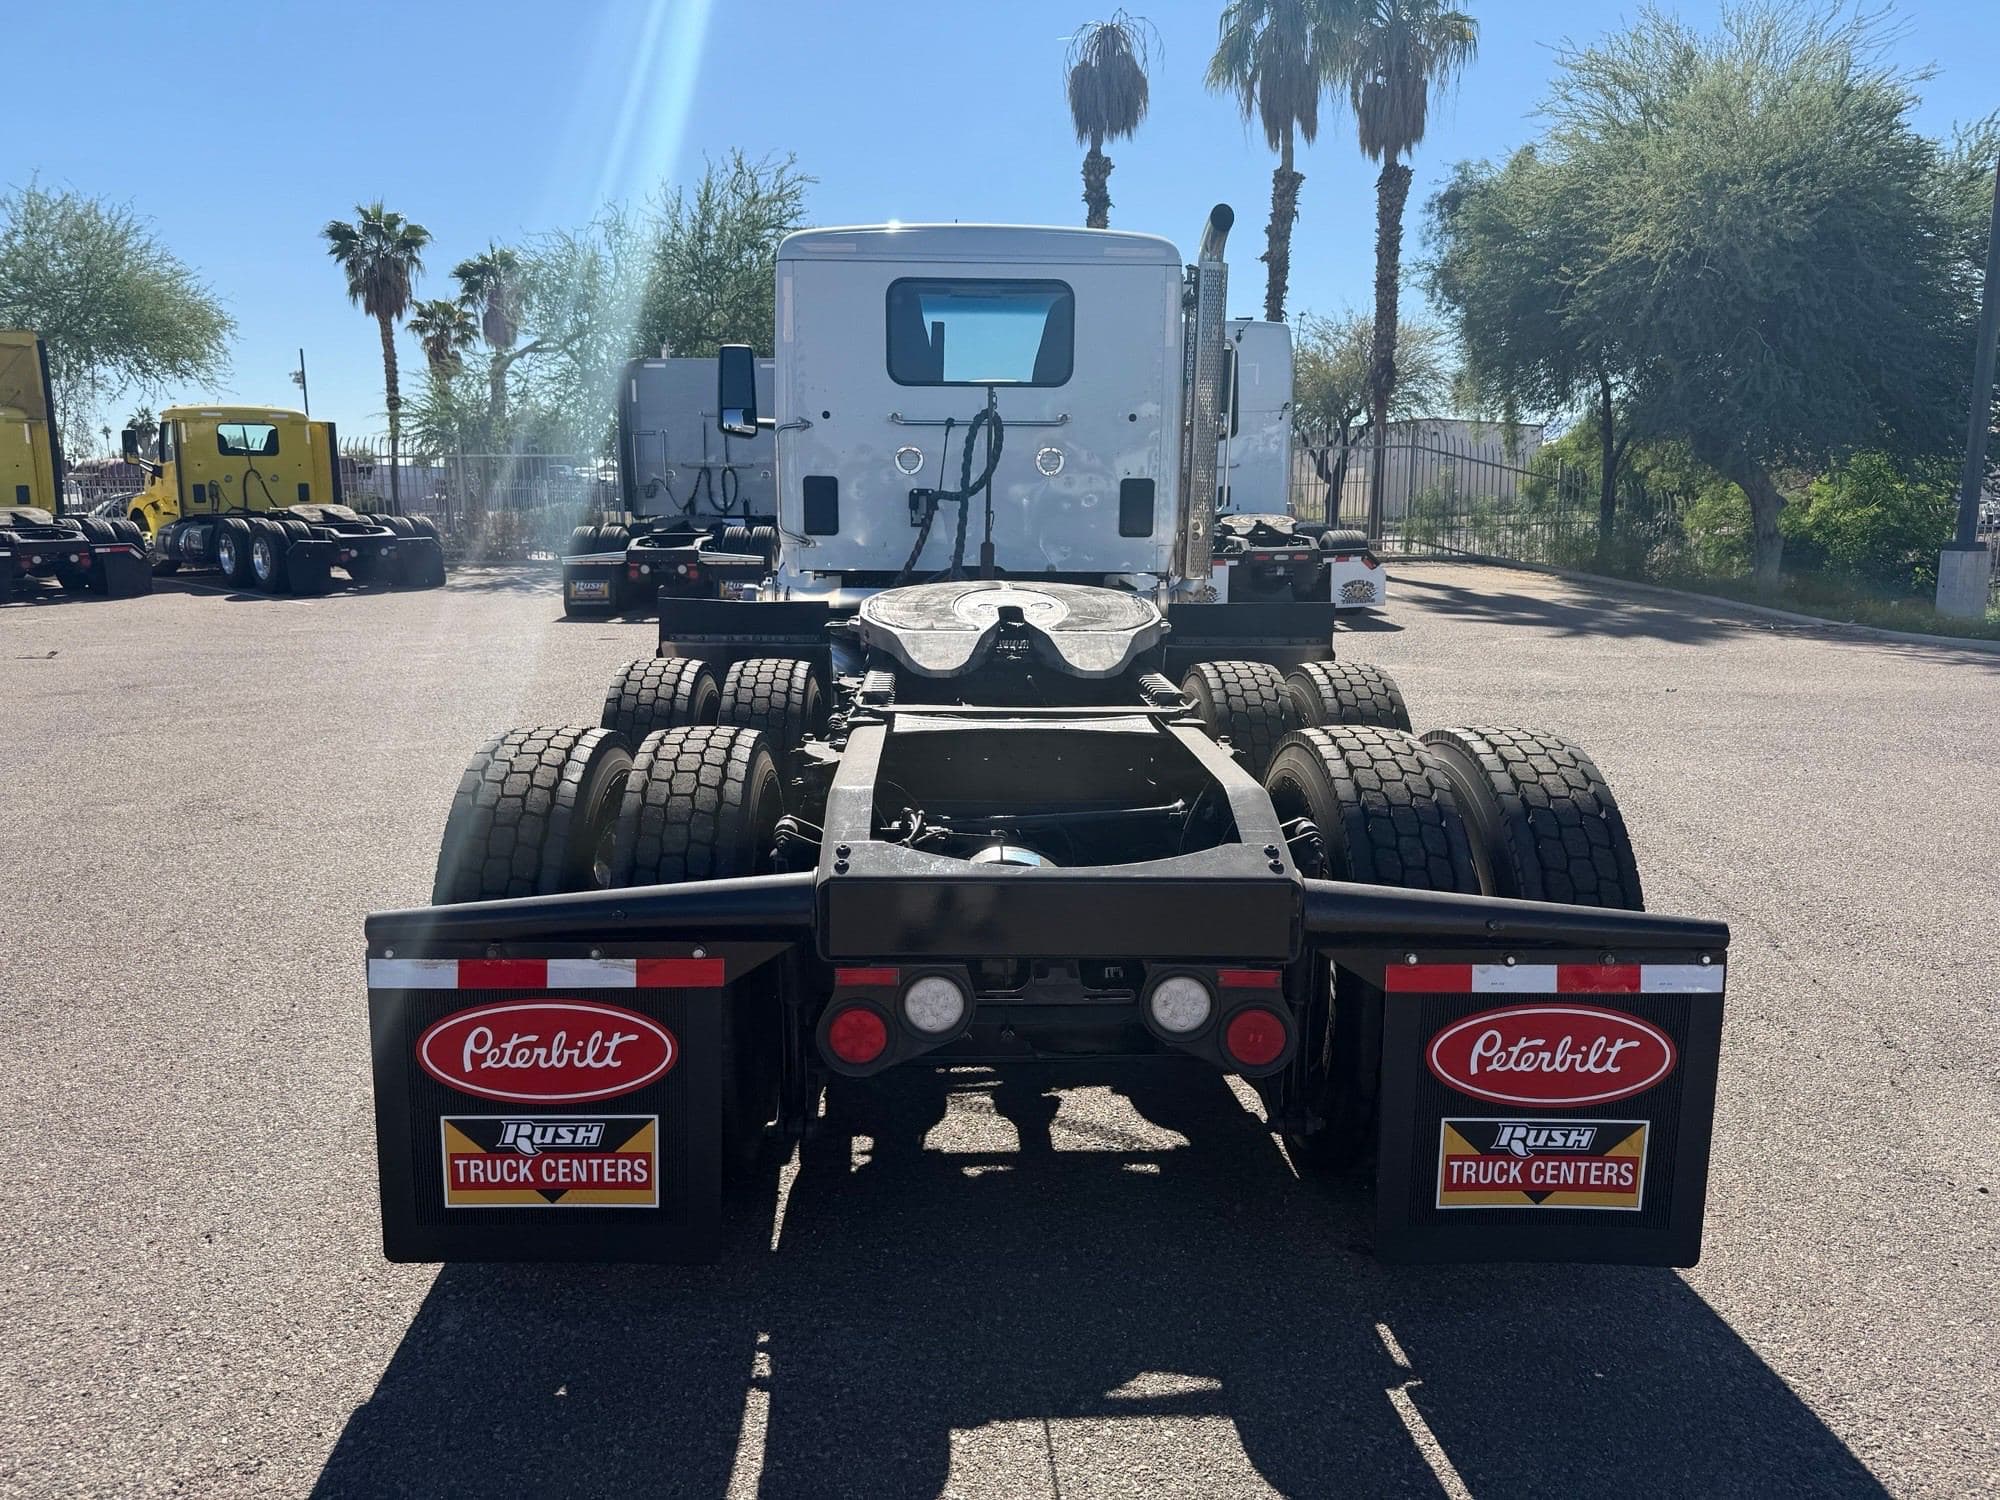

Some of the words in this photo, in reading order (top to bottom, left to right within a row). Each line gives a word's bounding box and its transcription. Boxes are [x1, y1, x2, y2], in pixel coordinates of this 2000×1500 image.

[462, 1026, 639, 1073] Peterbilt
[1470, 1029, 1641, 1076] Peterbilt
[499, 1121, 604, 1156] RUSH
[1493, 1123, 1596, 1158] RUSH
[454, 1159, 535, 1183] TRUCK
[541, 1158, 648, 1183] CENTERS
[1449, 1160, 1523, 1184] TRUCK
[1530, 1161, 1634, 1186] CENTERS
